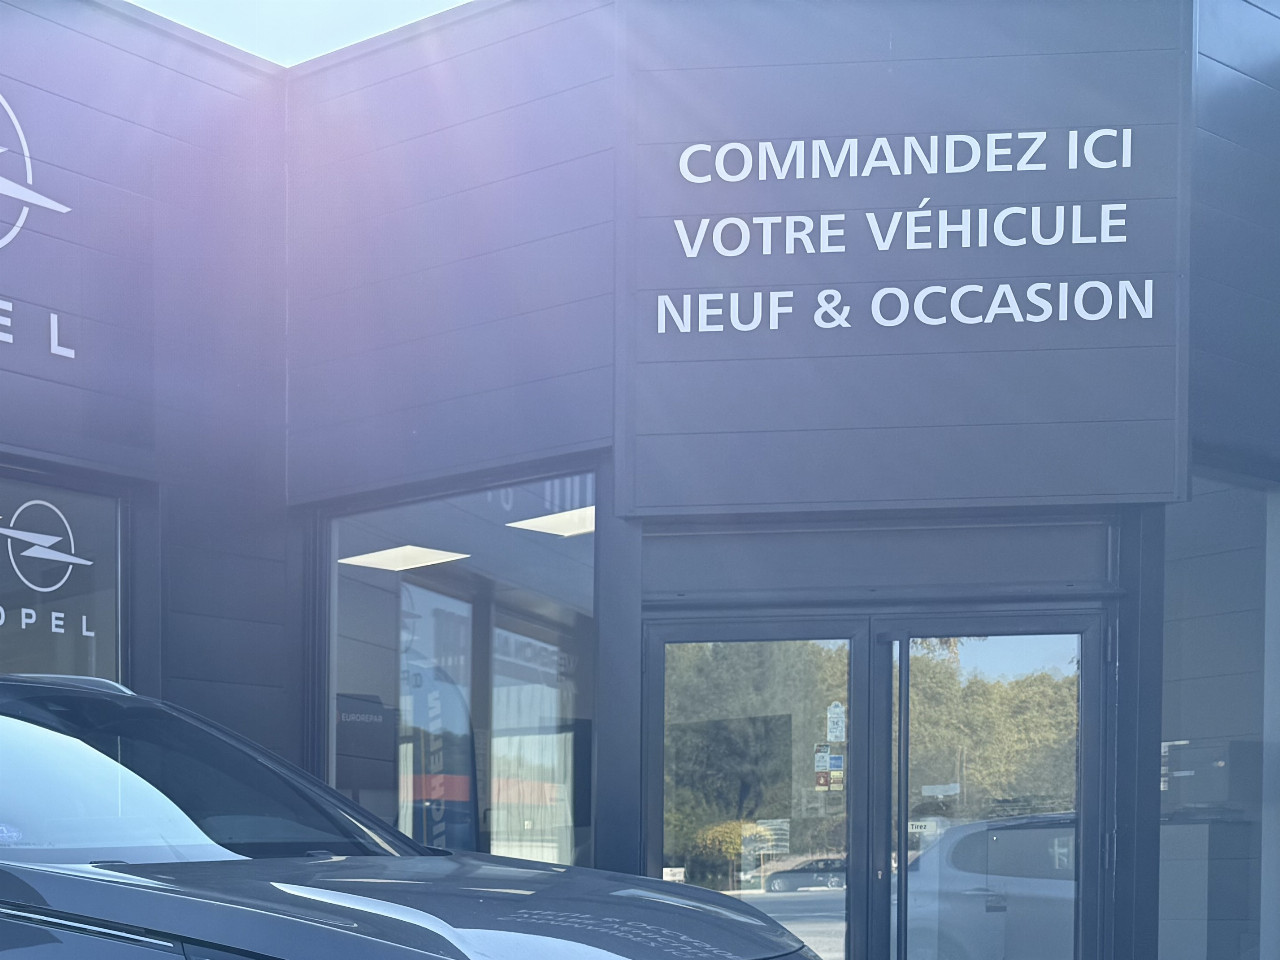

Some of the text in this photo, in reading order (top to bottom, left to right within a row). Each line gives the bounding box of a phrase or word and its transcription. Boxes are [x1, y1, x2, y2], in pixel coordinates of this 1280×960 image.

[679, 128, 1132, 184] COMMANDEZ ICI
[674, 197, 1127, 258] VOTRE VÉHICULE
[657, 279, 1153, 334] NEUF & OCCASION
[910, 823, 927, 831] Tirez
